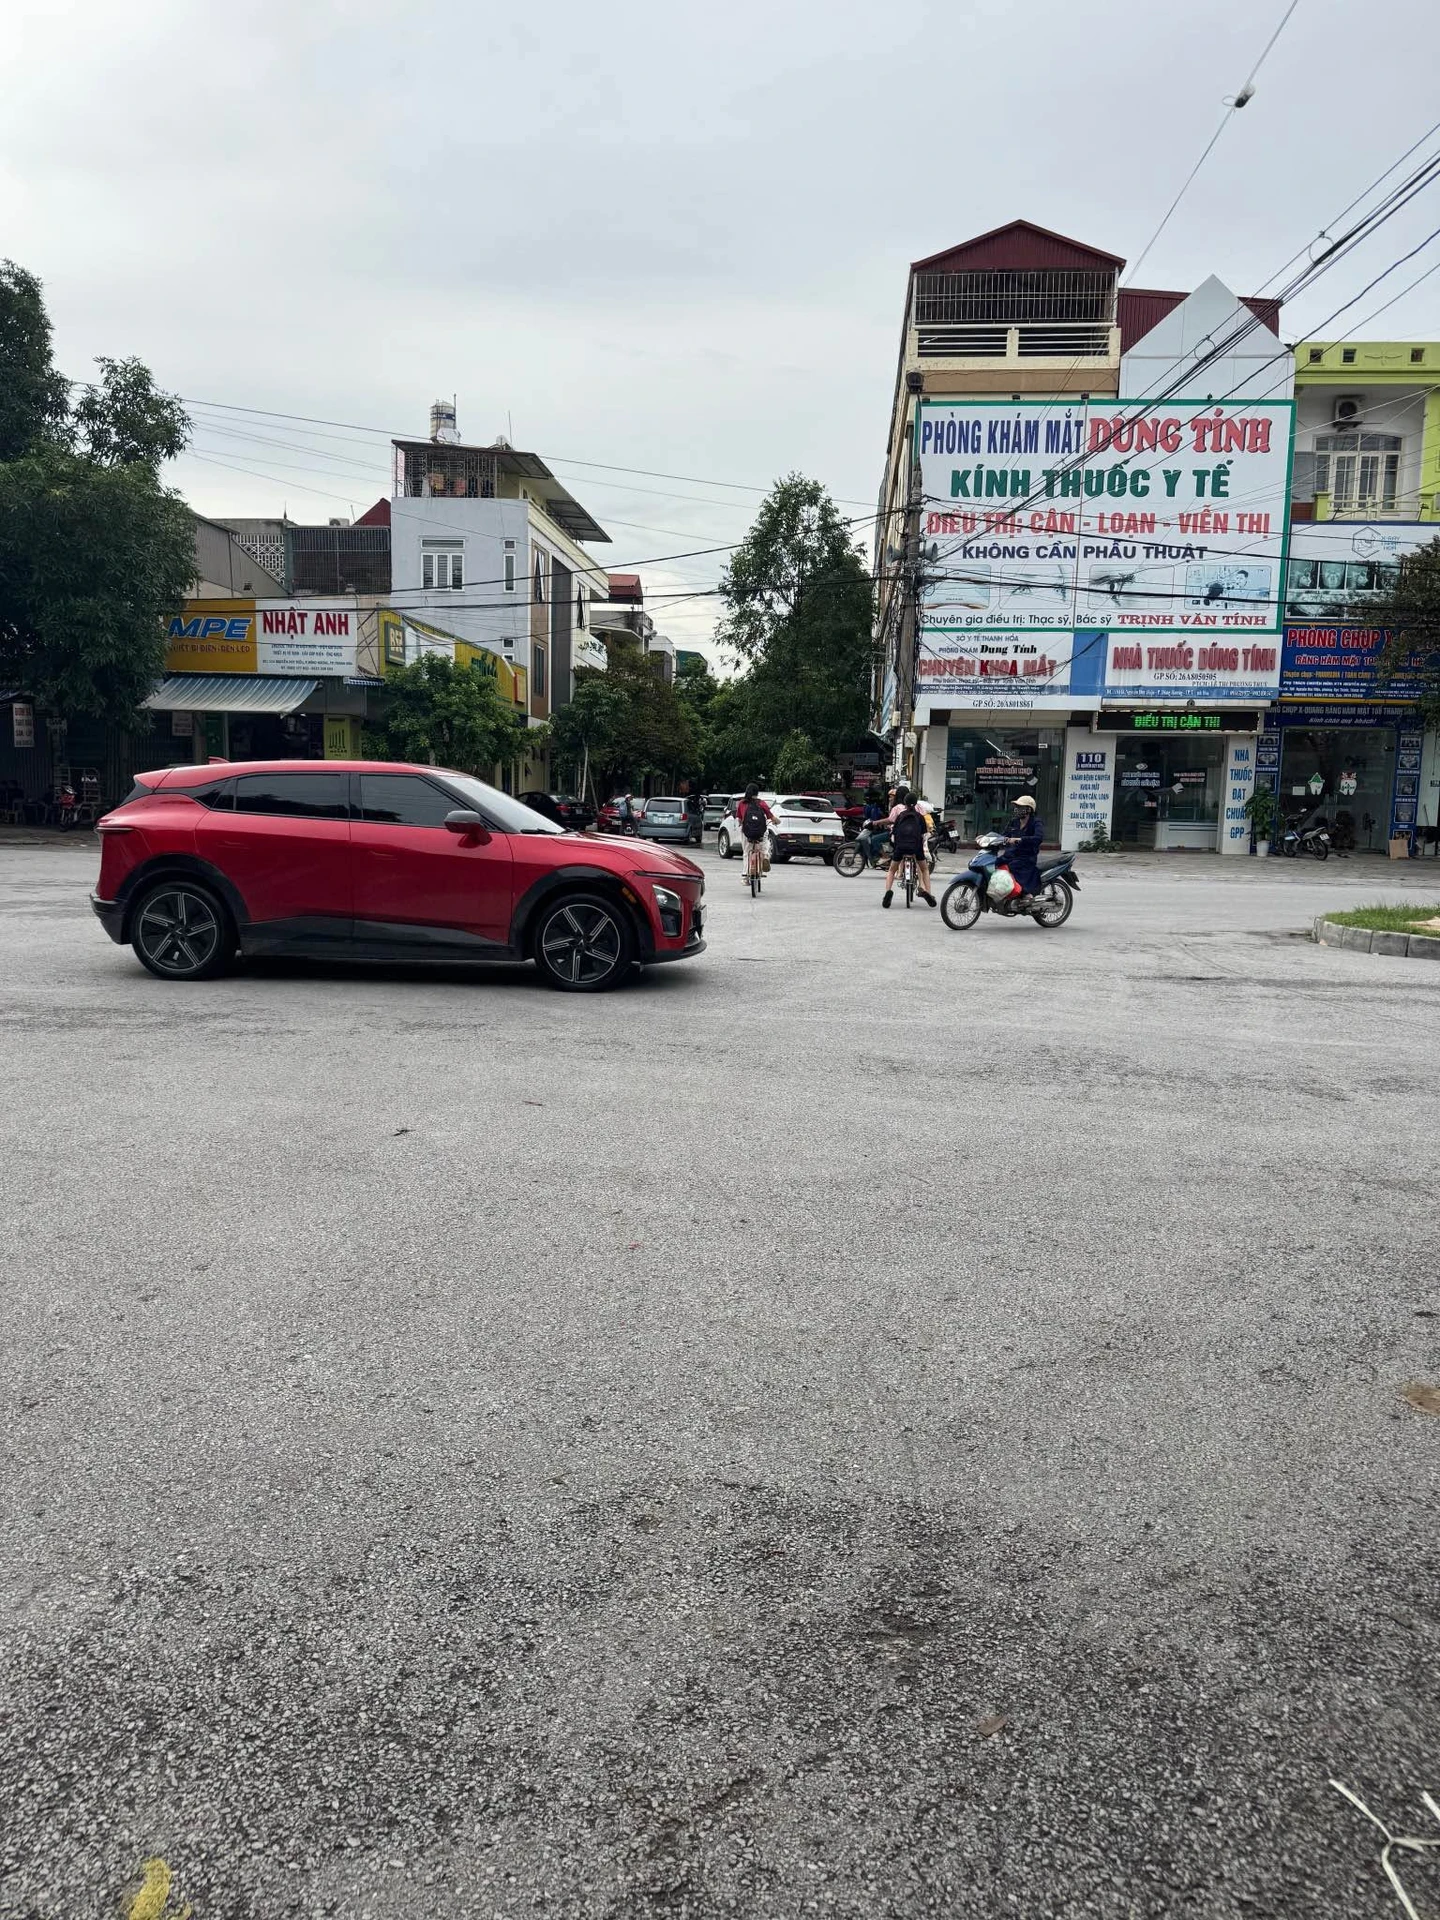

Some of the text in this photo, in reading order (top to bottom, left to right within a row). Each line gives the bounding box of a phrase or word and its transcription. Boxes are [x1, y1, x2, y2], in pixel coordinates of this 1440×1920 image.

[921, 412, 982, 454] PHÒNG
[987, 412, 1040, 454] KHÁM
[1045, 408, 1084, 454] MẮT
[1190, 407, 1272, 453] TÍNH
[950, 459, 1234, 498] KÍNH THUỐC Y TẾ
[1030, 508, 1075, 539] CẬN
[1098, 512, 1156, 538] LOẠN
[1178, 504, 1233, 534] VIỄN
[1236, 513, 1271, 539] THỊ
[963, 542, 1030, 559] KHÔNG
[1036, 540, 1077, 559] CẦN
[168, 617, 253, 640] MPE
[263, 606, 350, 639] NHẬT ANH
[921, 614, 963, 626] Chuyên
[965, 614, 983, 626] gia
[1013, 614, 1026, 626] trị:
[1028, 614, 1055, 626] Thạc
[1076, 613, 1097, 624] Bác
[1117, 614, 1175, 627] TRỊNH
[1179, 612, 1218, 625] VĂN
[1222, 612, 1267, 625] TÍNH
[1287, 624, 1337, 648] PHÒNG
[1340, 628, 1380, 653] CHỤP
[1012, 643, 1037, 654] Tính
[1112, 642, 1143, 670] NHÀ
[1147, 640, 1194, 670] THUỐC
[1242, 643, 1277, 671] TÍNH
[919, 656, 975, 676] CHUYÊN
[980, 660, 1018, 676] KHOA
[1295, 653, 1319, 666] RĂNG
[1320, 653, 1341, 666] HÀM
[1080, 753, 1102, 763] 110
[1234, 749, 1250, 762] NHÀ
[1230, 766, 1253, 781] THUỐC
[1232, 788, 1246, 802] ĐẠT
[1230, 827, 1245, 839] GPP
